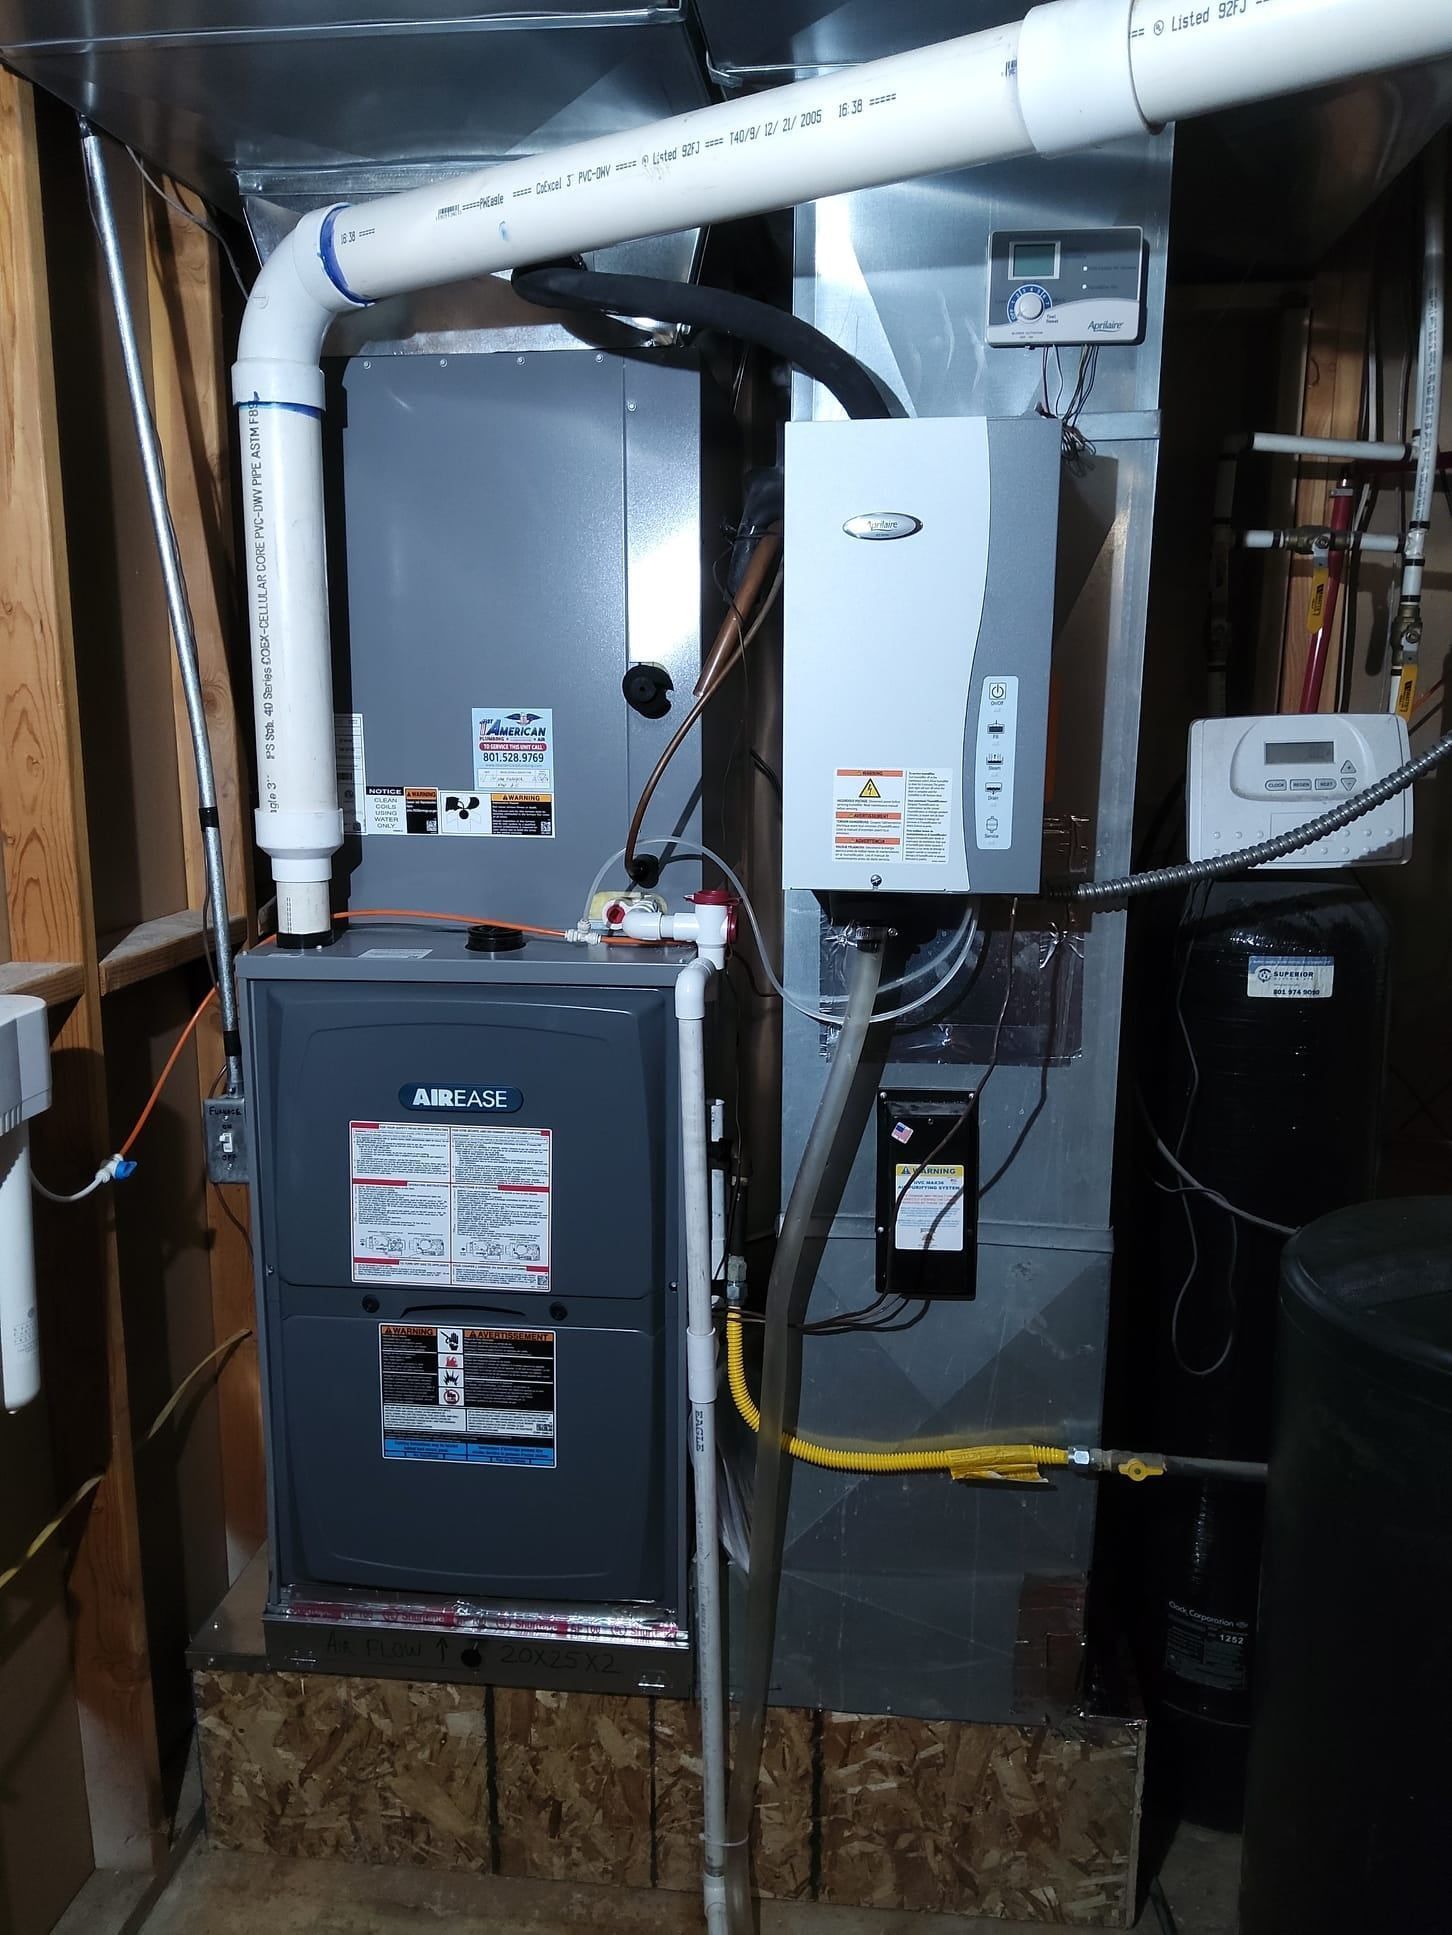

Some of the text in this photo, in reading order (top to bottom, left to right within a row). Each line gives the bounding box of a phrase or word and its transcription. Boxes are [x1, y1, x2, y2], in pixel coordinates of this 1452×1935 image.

[1171, 7, 1210, 32] Listed
[838, 98, 863, 118] 16:38
[535, 177, 562, 195] CoExcel
[652, 147, 677, 166] Listed
[681, 141, 701, 158] 92FJ
[800, 110, 822, 128] 2005
[1087, 320, 1124, 332] Aprilaire
[249, 427, 261, 459] ASTM
[251, 462, 262, 487] PIPE
[252, 489, 265, 540] PVC-DWV
[255, 541, 266, 572] CORE
[256, 574, 272, 666] COEX-CELLULAR
[262, 668, 273, 700] Series
[264, 702, 274, 717] 40
[486, 719, 547, 737] AMERICAN
[483, 752, 544, 763] 801.528.9769
[412, 1088, 508, 1108] AIREASE
[394, 1327, 434, 1336] WARNING
[478, 1331, 549, 1341] AVERTISSEMENT
[694, 1410, 705, 1452] EAGLE
[1189, 1609, 1234, 1627] Corporation
[1220, 1634, 1244, 1645] 1252
